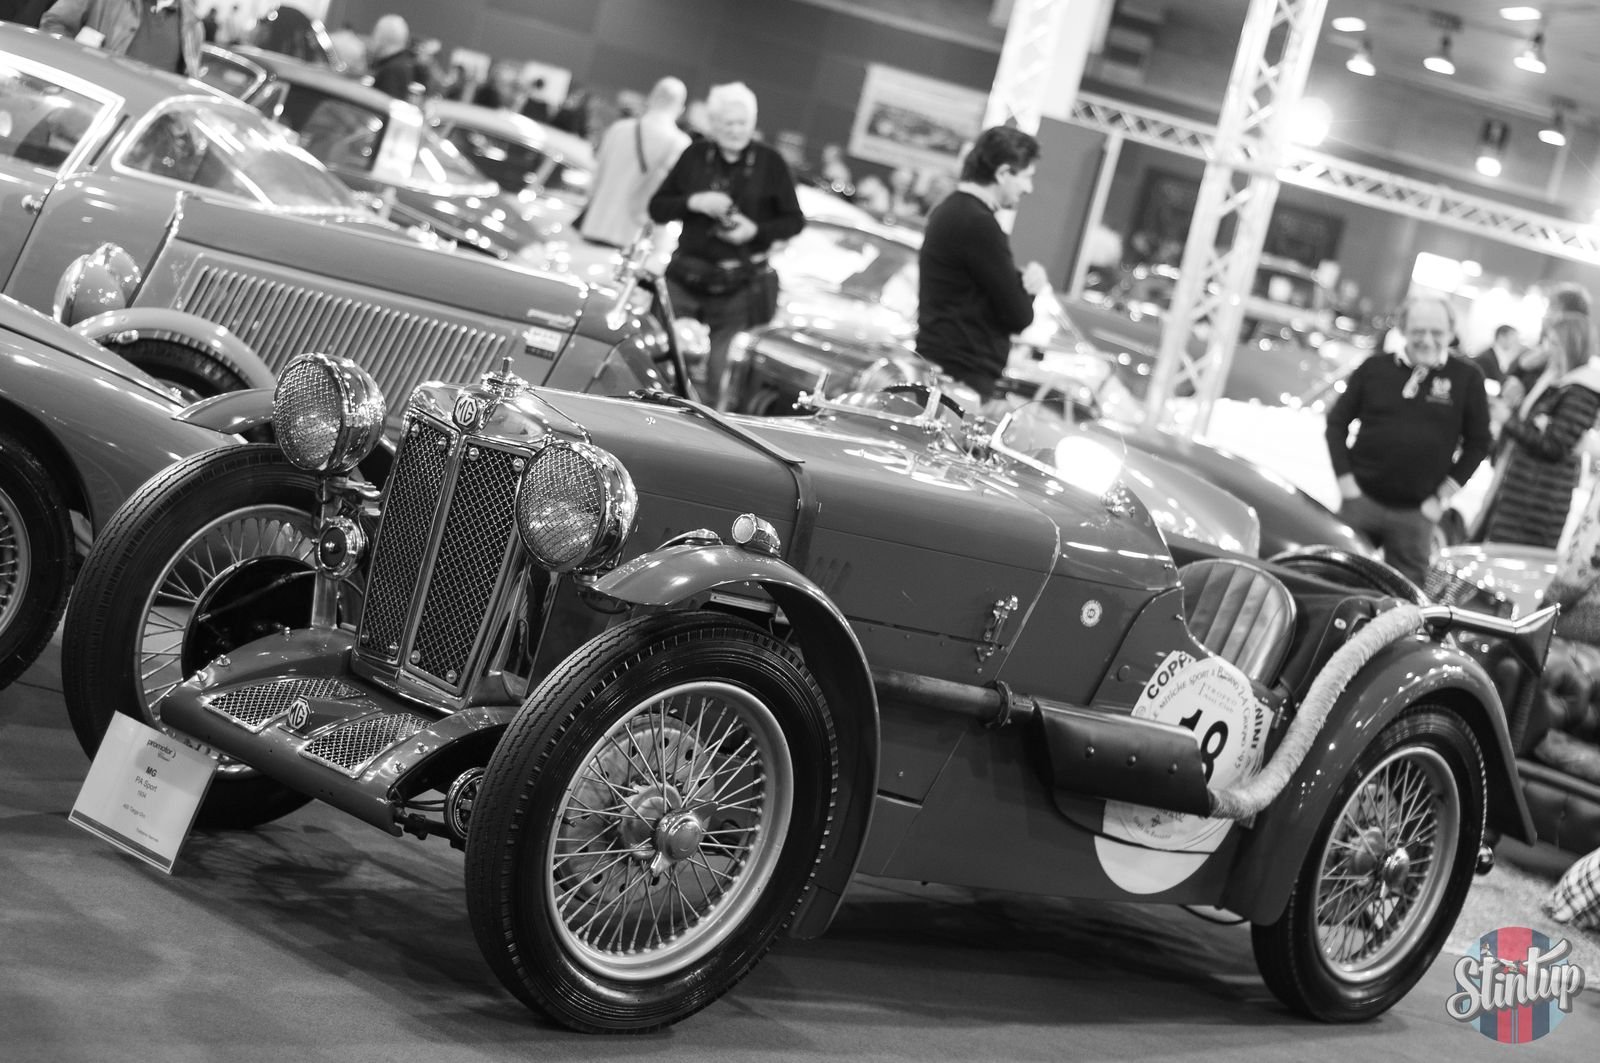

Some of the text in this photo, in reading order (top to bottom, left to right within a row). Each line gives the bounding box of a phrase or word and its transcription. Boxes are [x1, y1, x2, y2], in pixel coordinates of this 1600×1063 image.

[456, 398, 476, 424] MG
[1147, 653, 1192, 700] COPP
[1250, 702, 1264, 750] NINI
[290, 702, 307, 727] MG
[145, 766, 158, 777] MG
[143, 779, 158, 792] Sport
